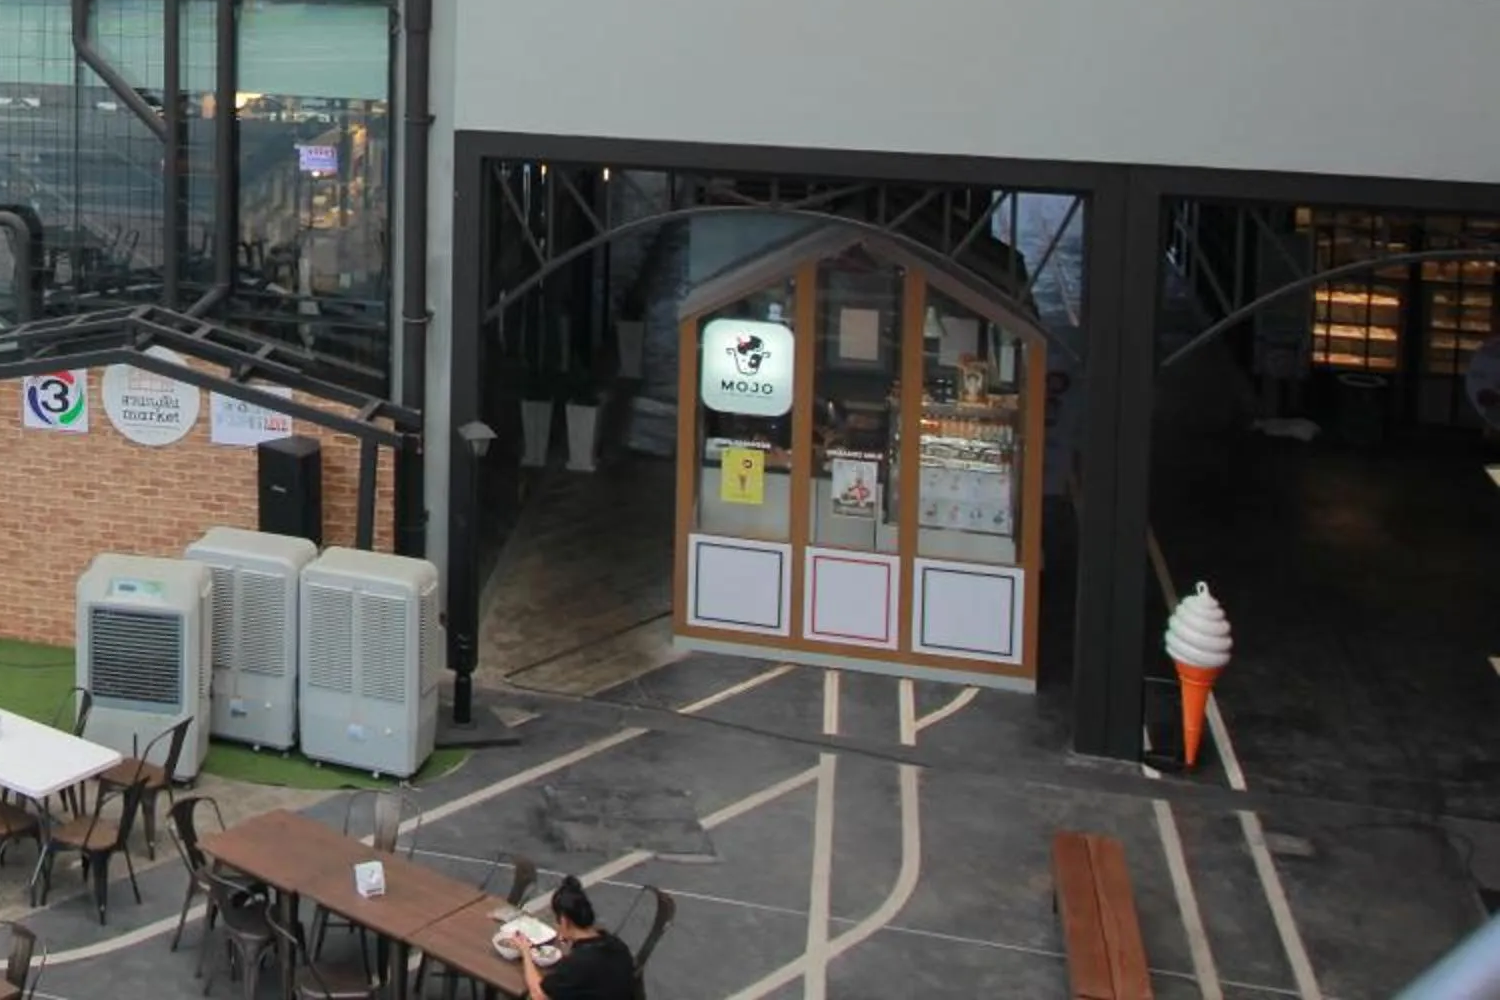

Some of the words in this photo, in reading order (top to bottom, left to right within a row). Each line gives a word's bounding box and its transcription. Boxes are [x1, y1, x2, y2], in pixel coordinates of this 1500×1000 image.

[721, 379, 773, 395] MOJO
[40, 379, 69, 412] 3
[122, 407, 180, 423] market
